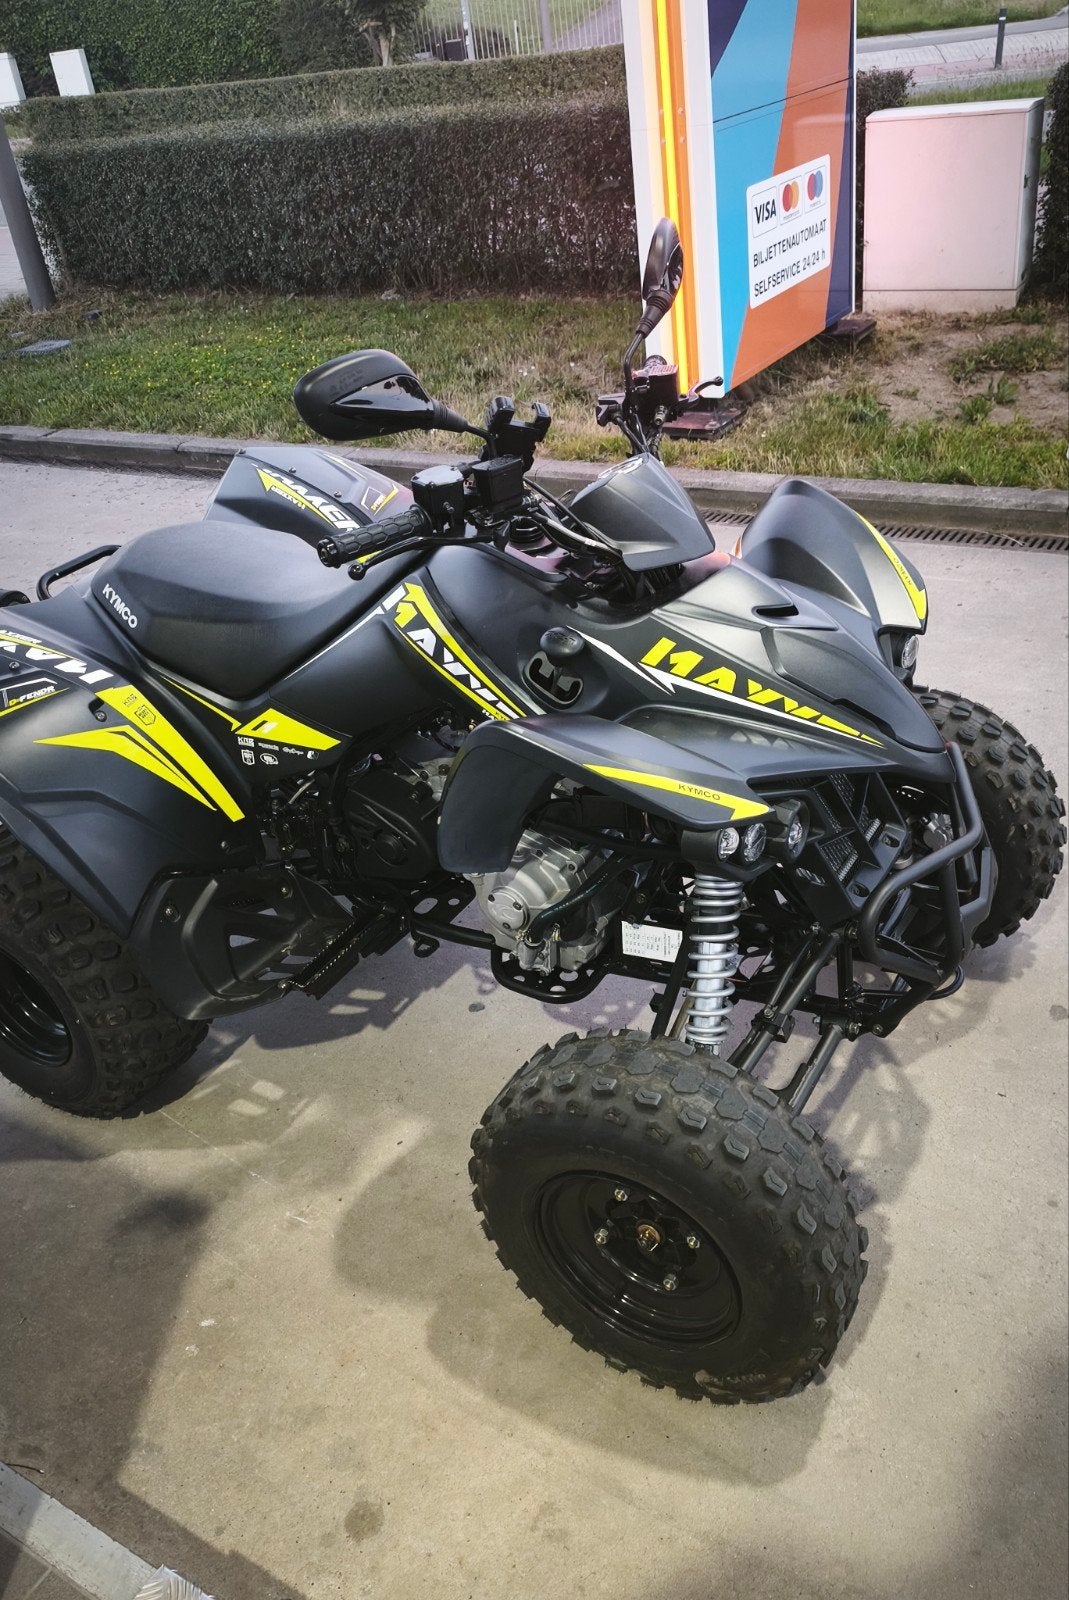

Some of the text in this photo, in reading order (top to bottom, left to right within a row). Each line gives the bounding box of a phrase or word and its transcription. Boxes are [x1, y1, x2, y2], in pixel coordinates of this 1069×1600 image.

[754, 199, 777, 224] VISA
[753, 218, 827, 268] BILJETTENAUTOMAAT
[754, 260, 801, 297] SELFSERVICE
[102, 583, 138, 628] KYMCO
[678, 783, 721, 801] KYMCO
